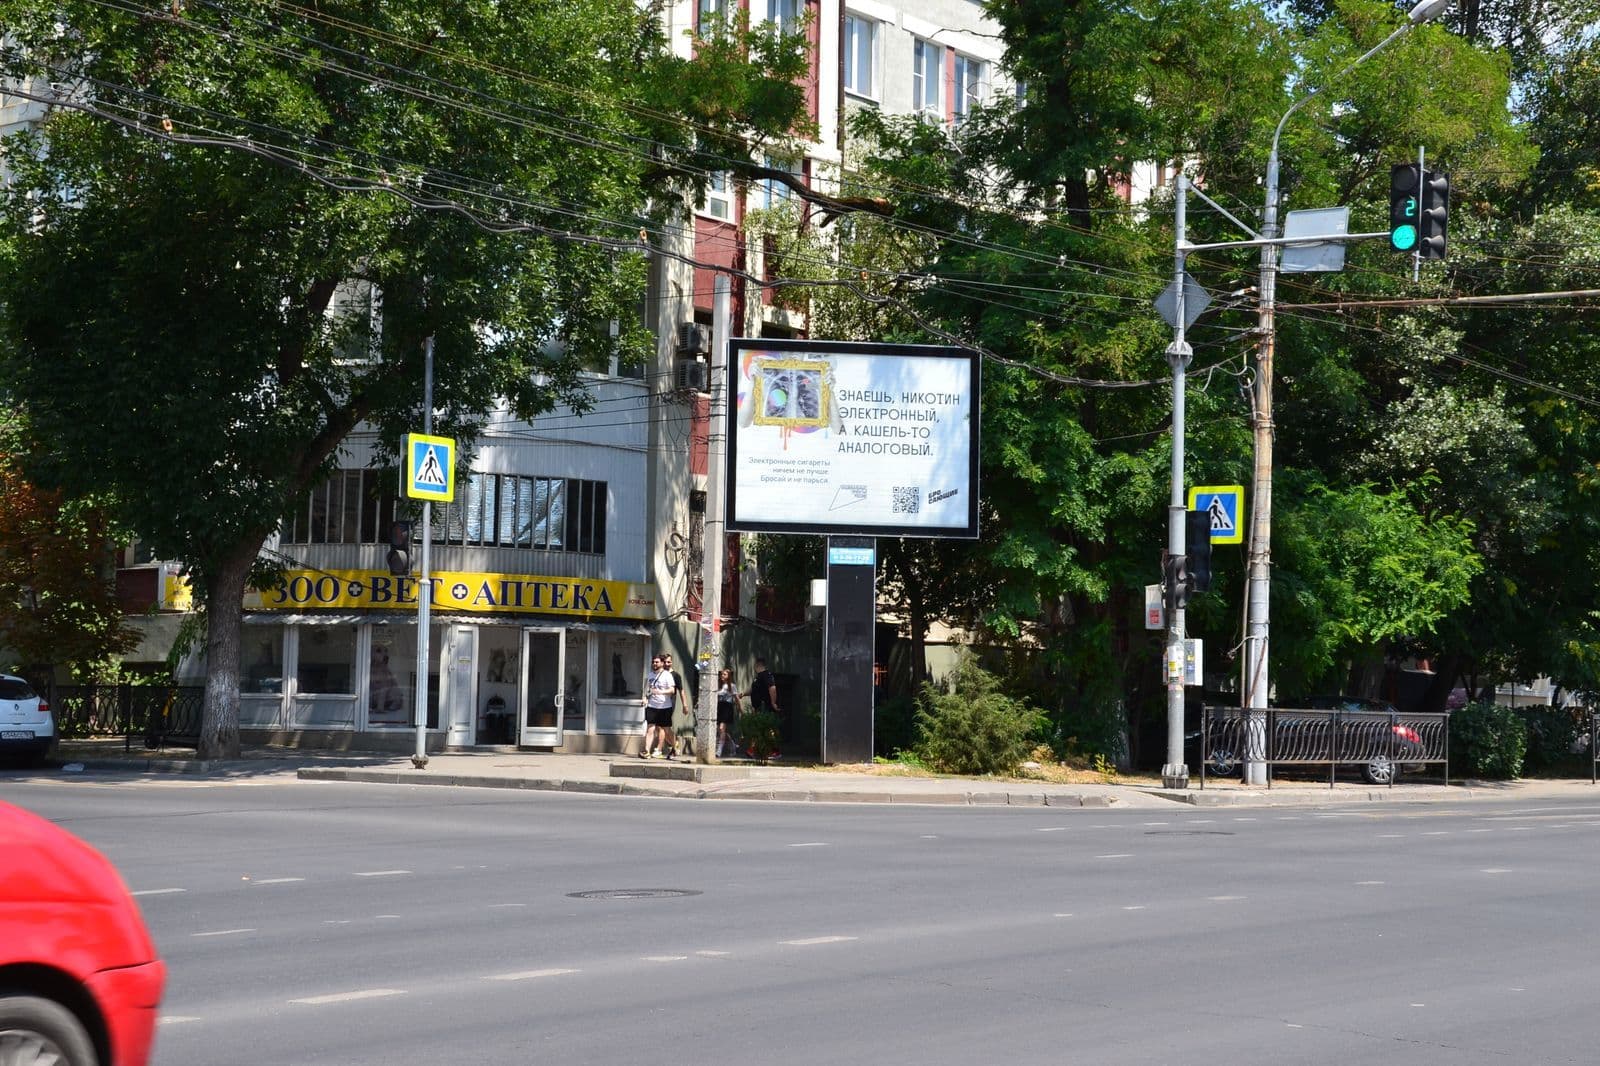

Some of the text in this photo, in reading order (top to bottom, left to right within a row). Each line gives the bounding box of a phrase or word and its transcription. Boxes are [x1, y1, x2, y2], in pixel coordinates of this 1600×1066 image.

[1405, 200, 1415, 217] 2
[839, 389, 960, 405] ЗНАЕШЬ, НИКОТИН
[839, 406, 940, 423] ЭЛЕКТРОННЫЙ,
[838, 424, 931, 439] А КАШЕЛЬ-ТО
[838, 441, 934, 457] АНАЛОГОВЫЙ.
[748, 456, 831, 467] Электронные сигареты
[760, 474, 786, 483] Бросай
[472, 580, 614, 612] АПТЕКА
